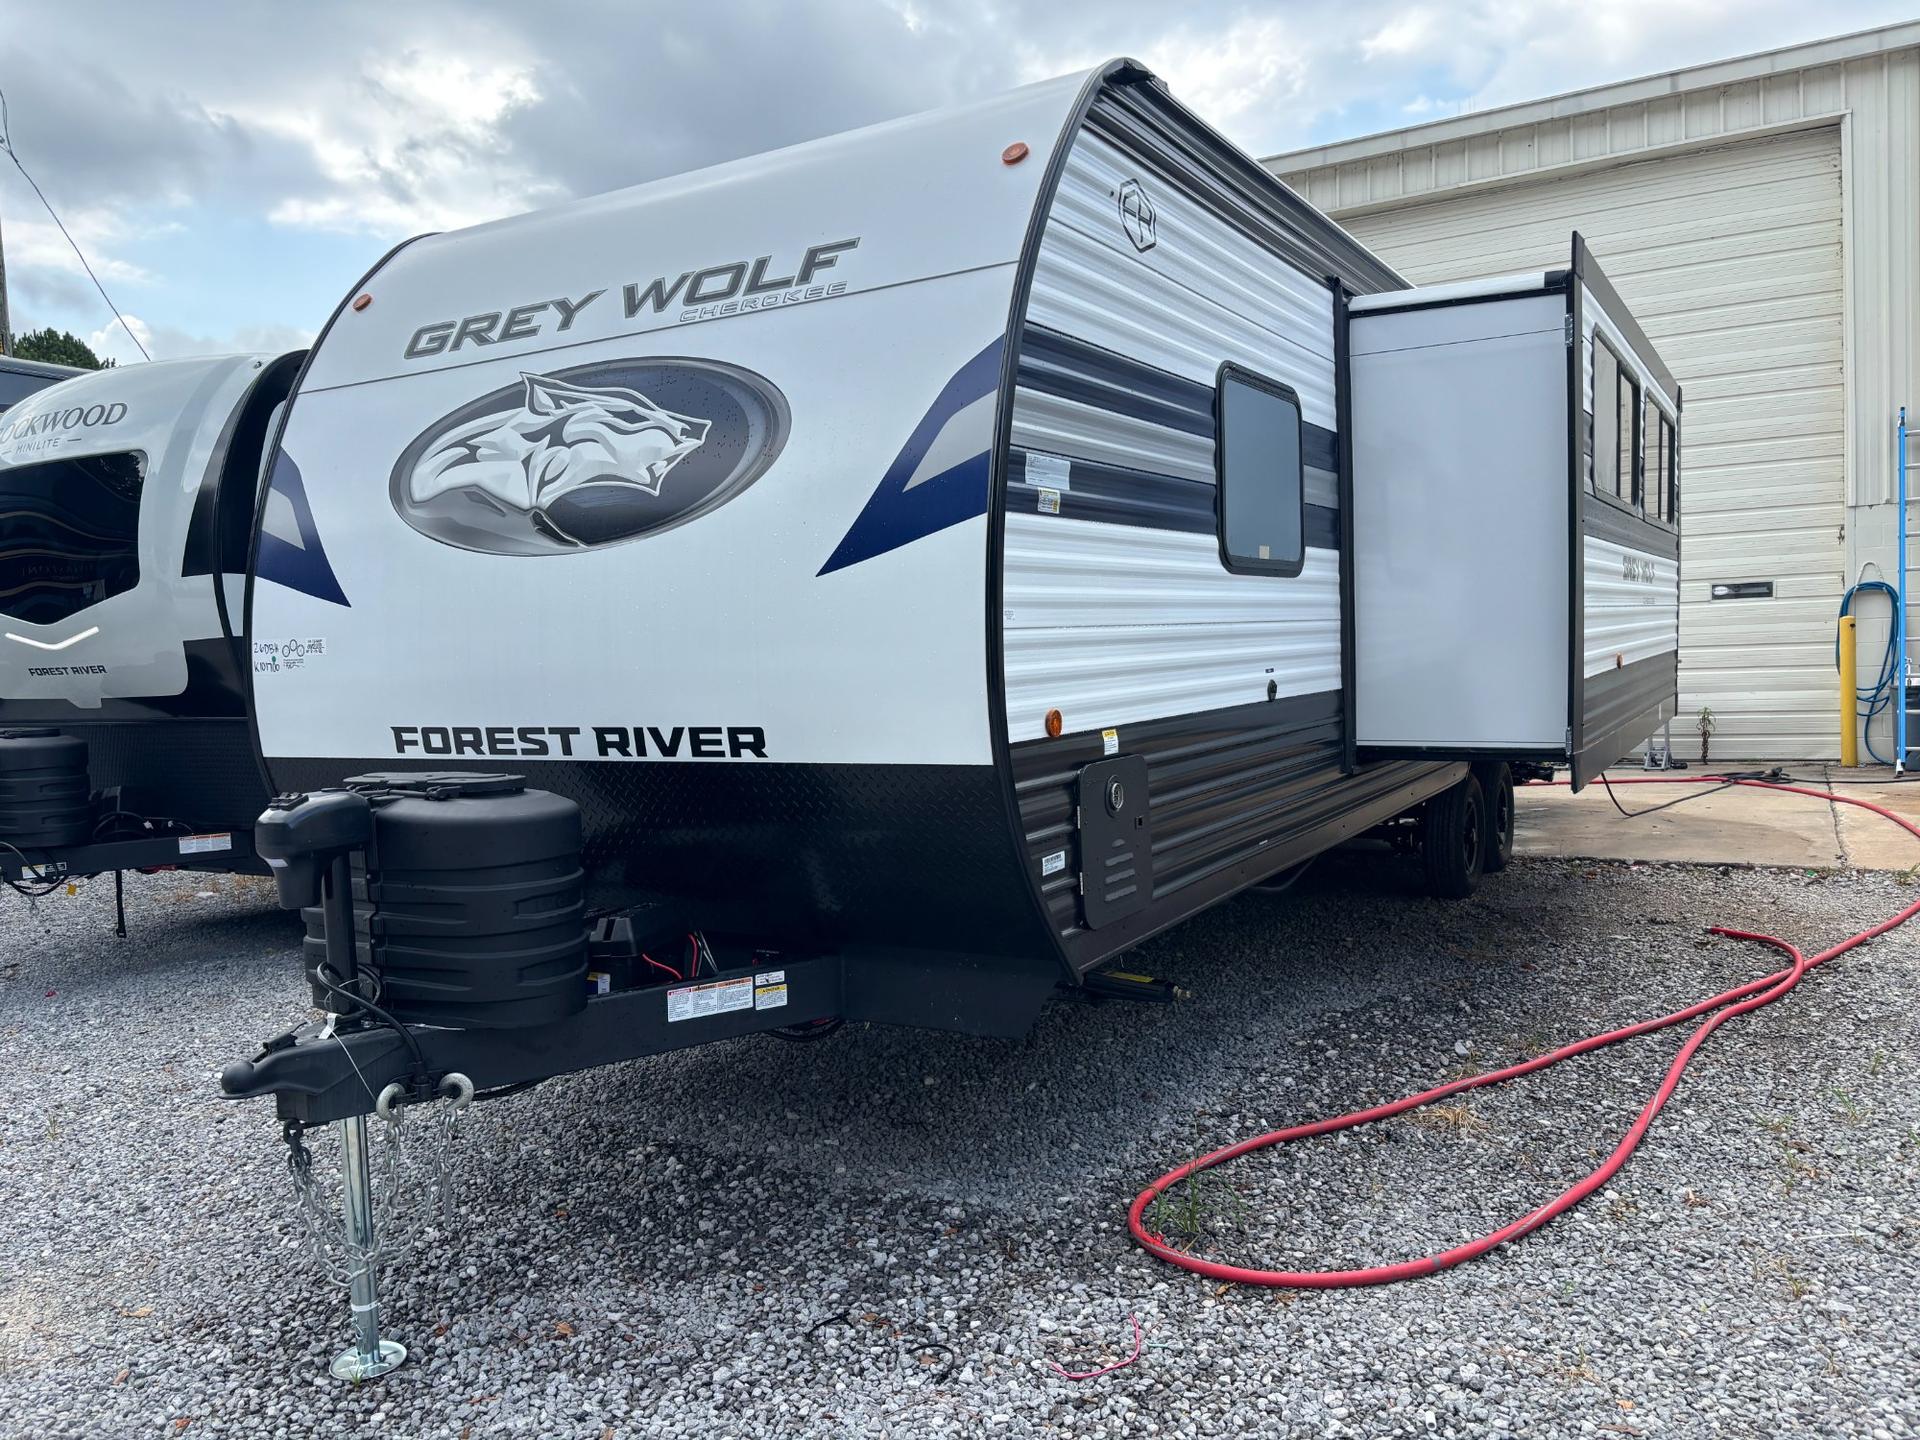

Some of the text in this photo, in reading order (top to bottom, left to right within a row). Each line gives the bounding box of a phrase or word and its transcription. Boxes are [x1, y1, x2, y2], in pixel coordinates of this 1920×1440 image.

[403, 237, 861, 359] GREY WOLF
[680, 280, 849, 323] CHEROKEE
[0, 402, 128, 443] OCKWOOD
[28, 664, 107, 677] FOREST RIVER
[390, 726, 769, 759] FOREST RIVER
